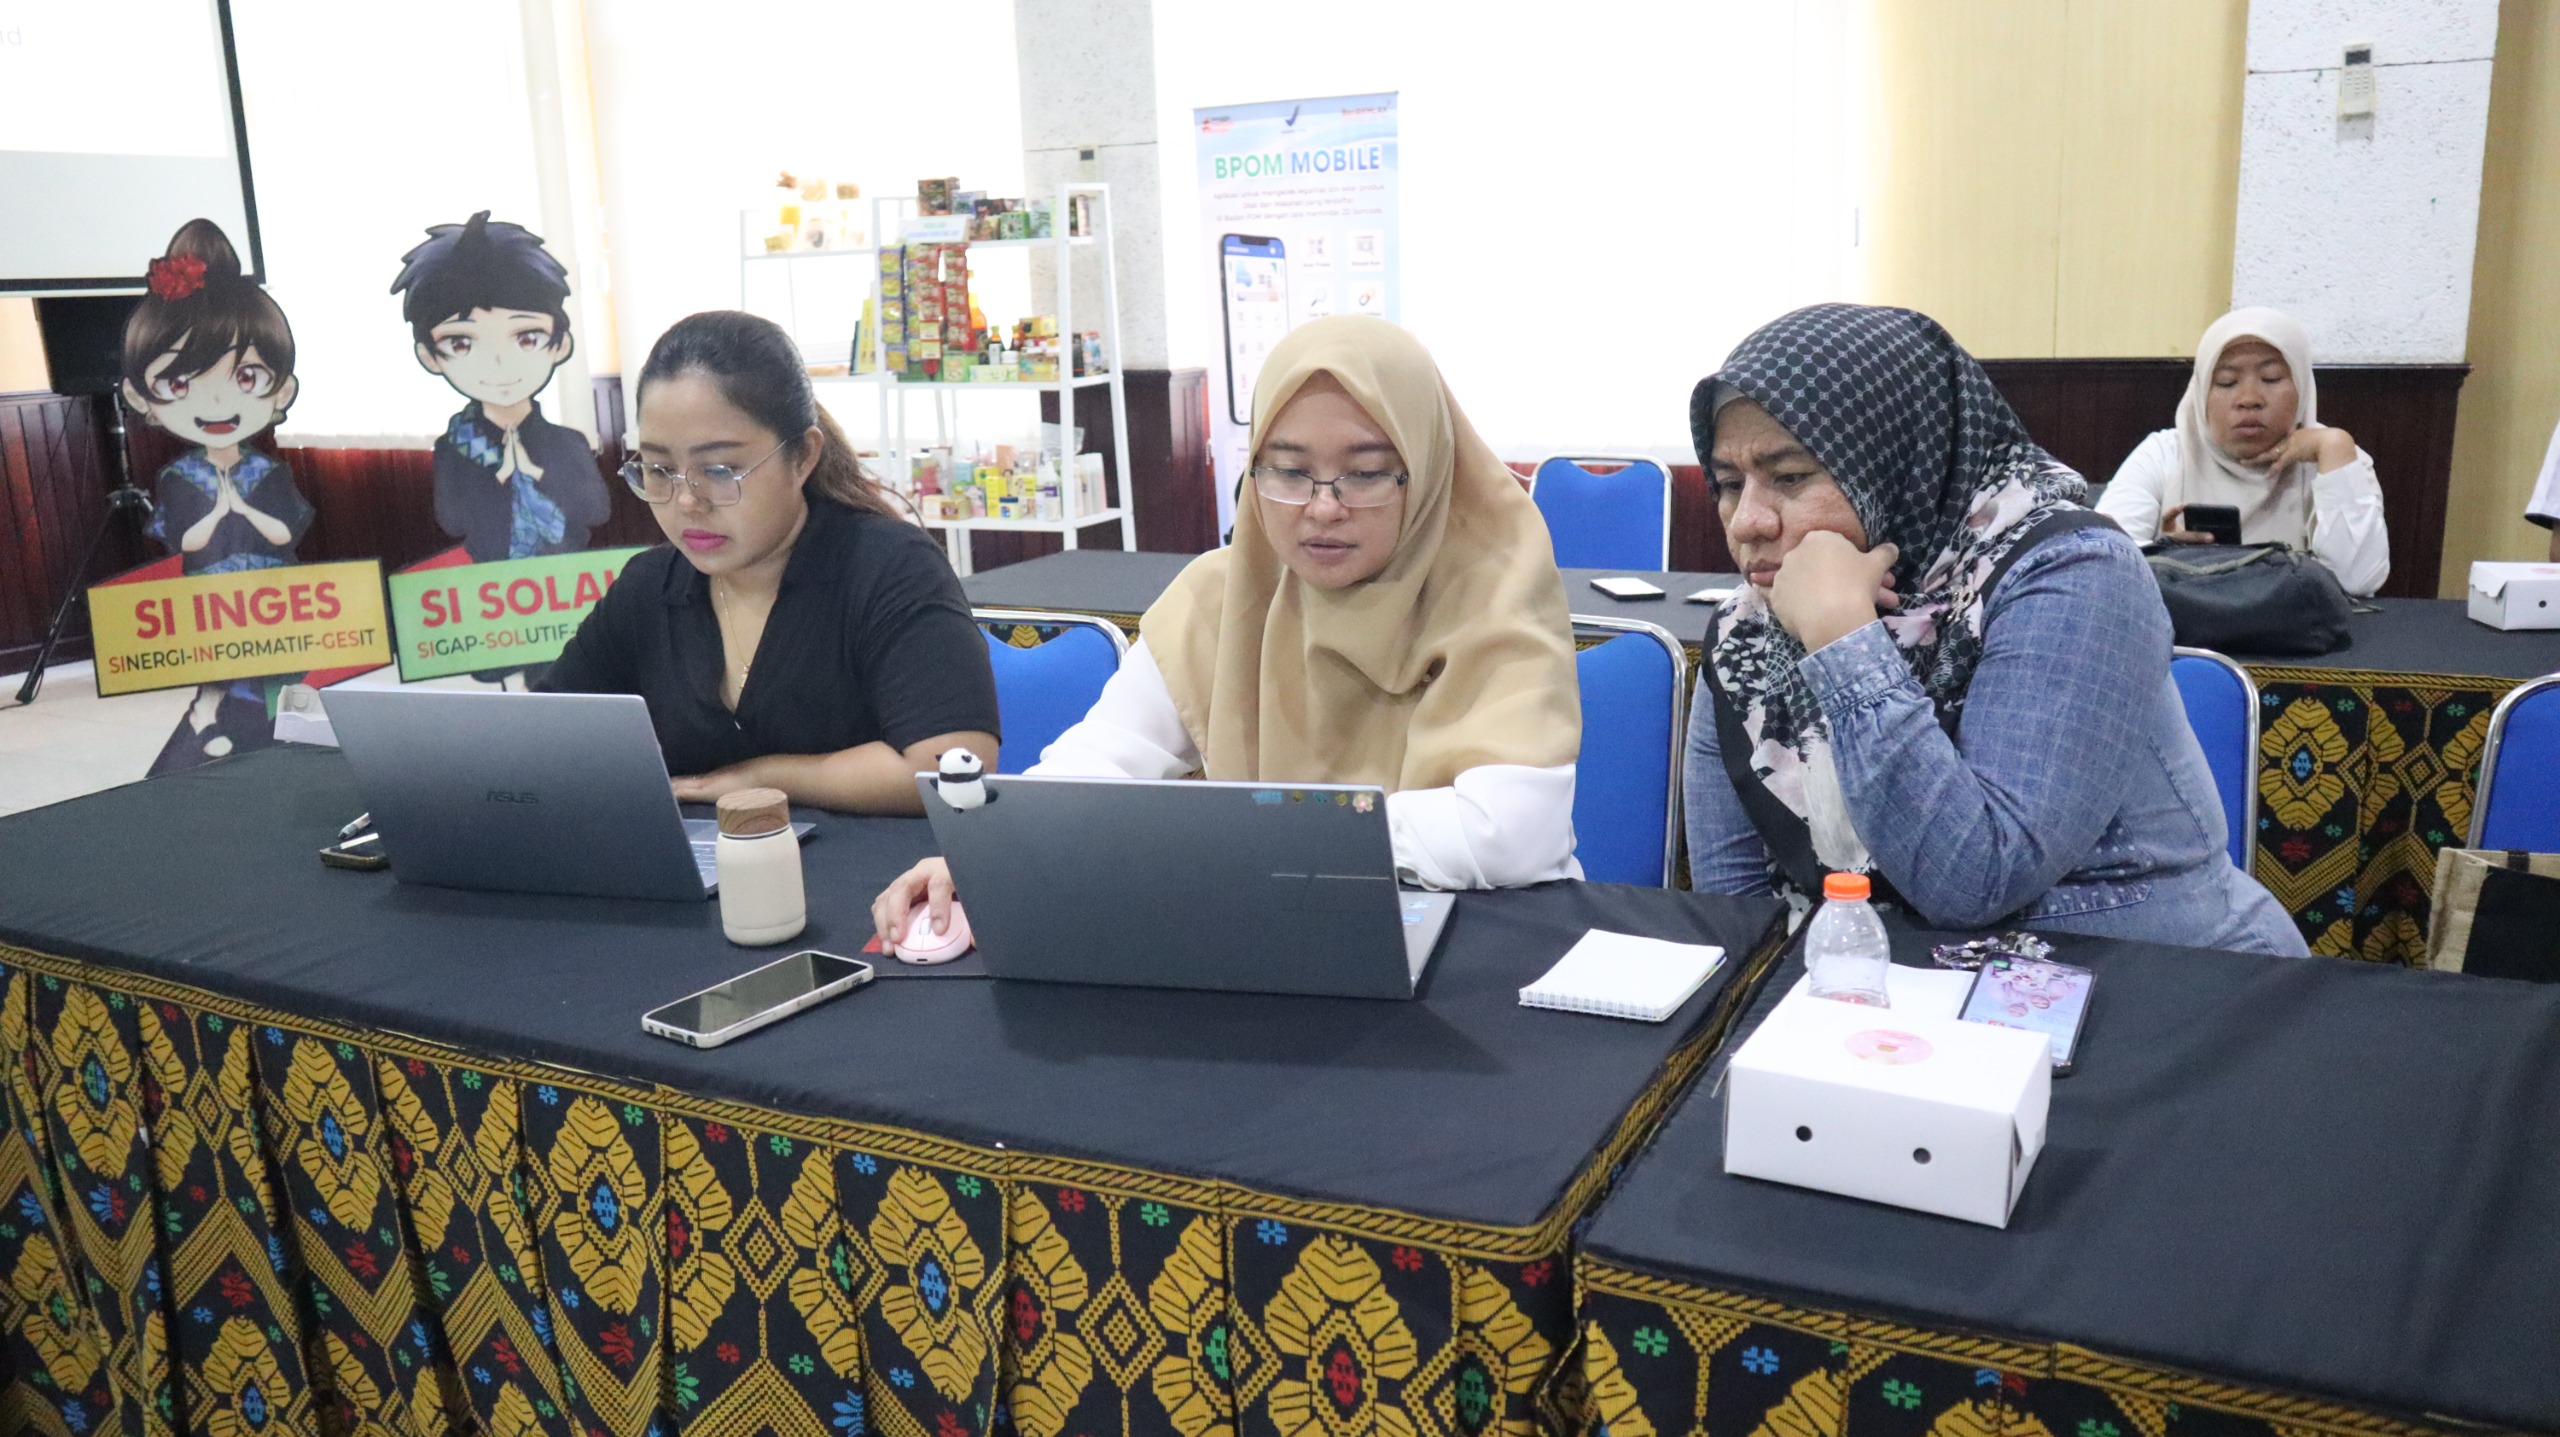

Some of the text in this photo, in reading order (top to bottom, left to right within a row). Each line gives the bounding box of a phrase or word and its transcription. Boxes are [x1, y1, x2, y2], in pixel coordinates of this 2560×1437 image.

[1215, 147, 1380, 180] BPOM MOBILE
[135, 582, 342, 640] SI INGES
[420, 587, 463, 628] SI
[108, 628, 376, 675] SINERGI-INFORMATIF-GESIT
[416, 622, 584, 660] SIGAP-SOLUTIF-
[486, 790, 540, 804] ASUS
